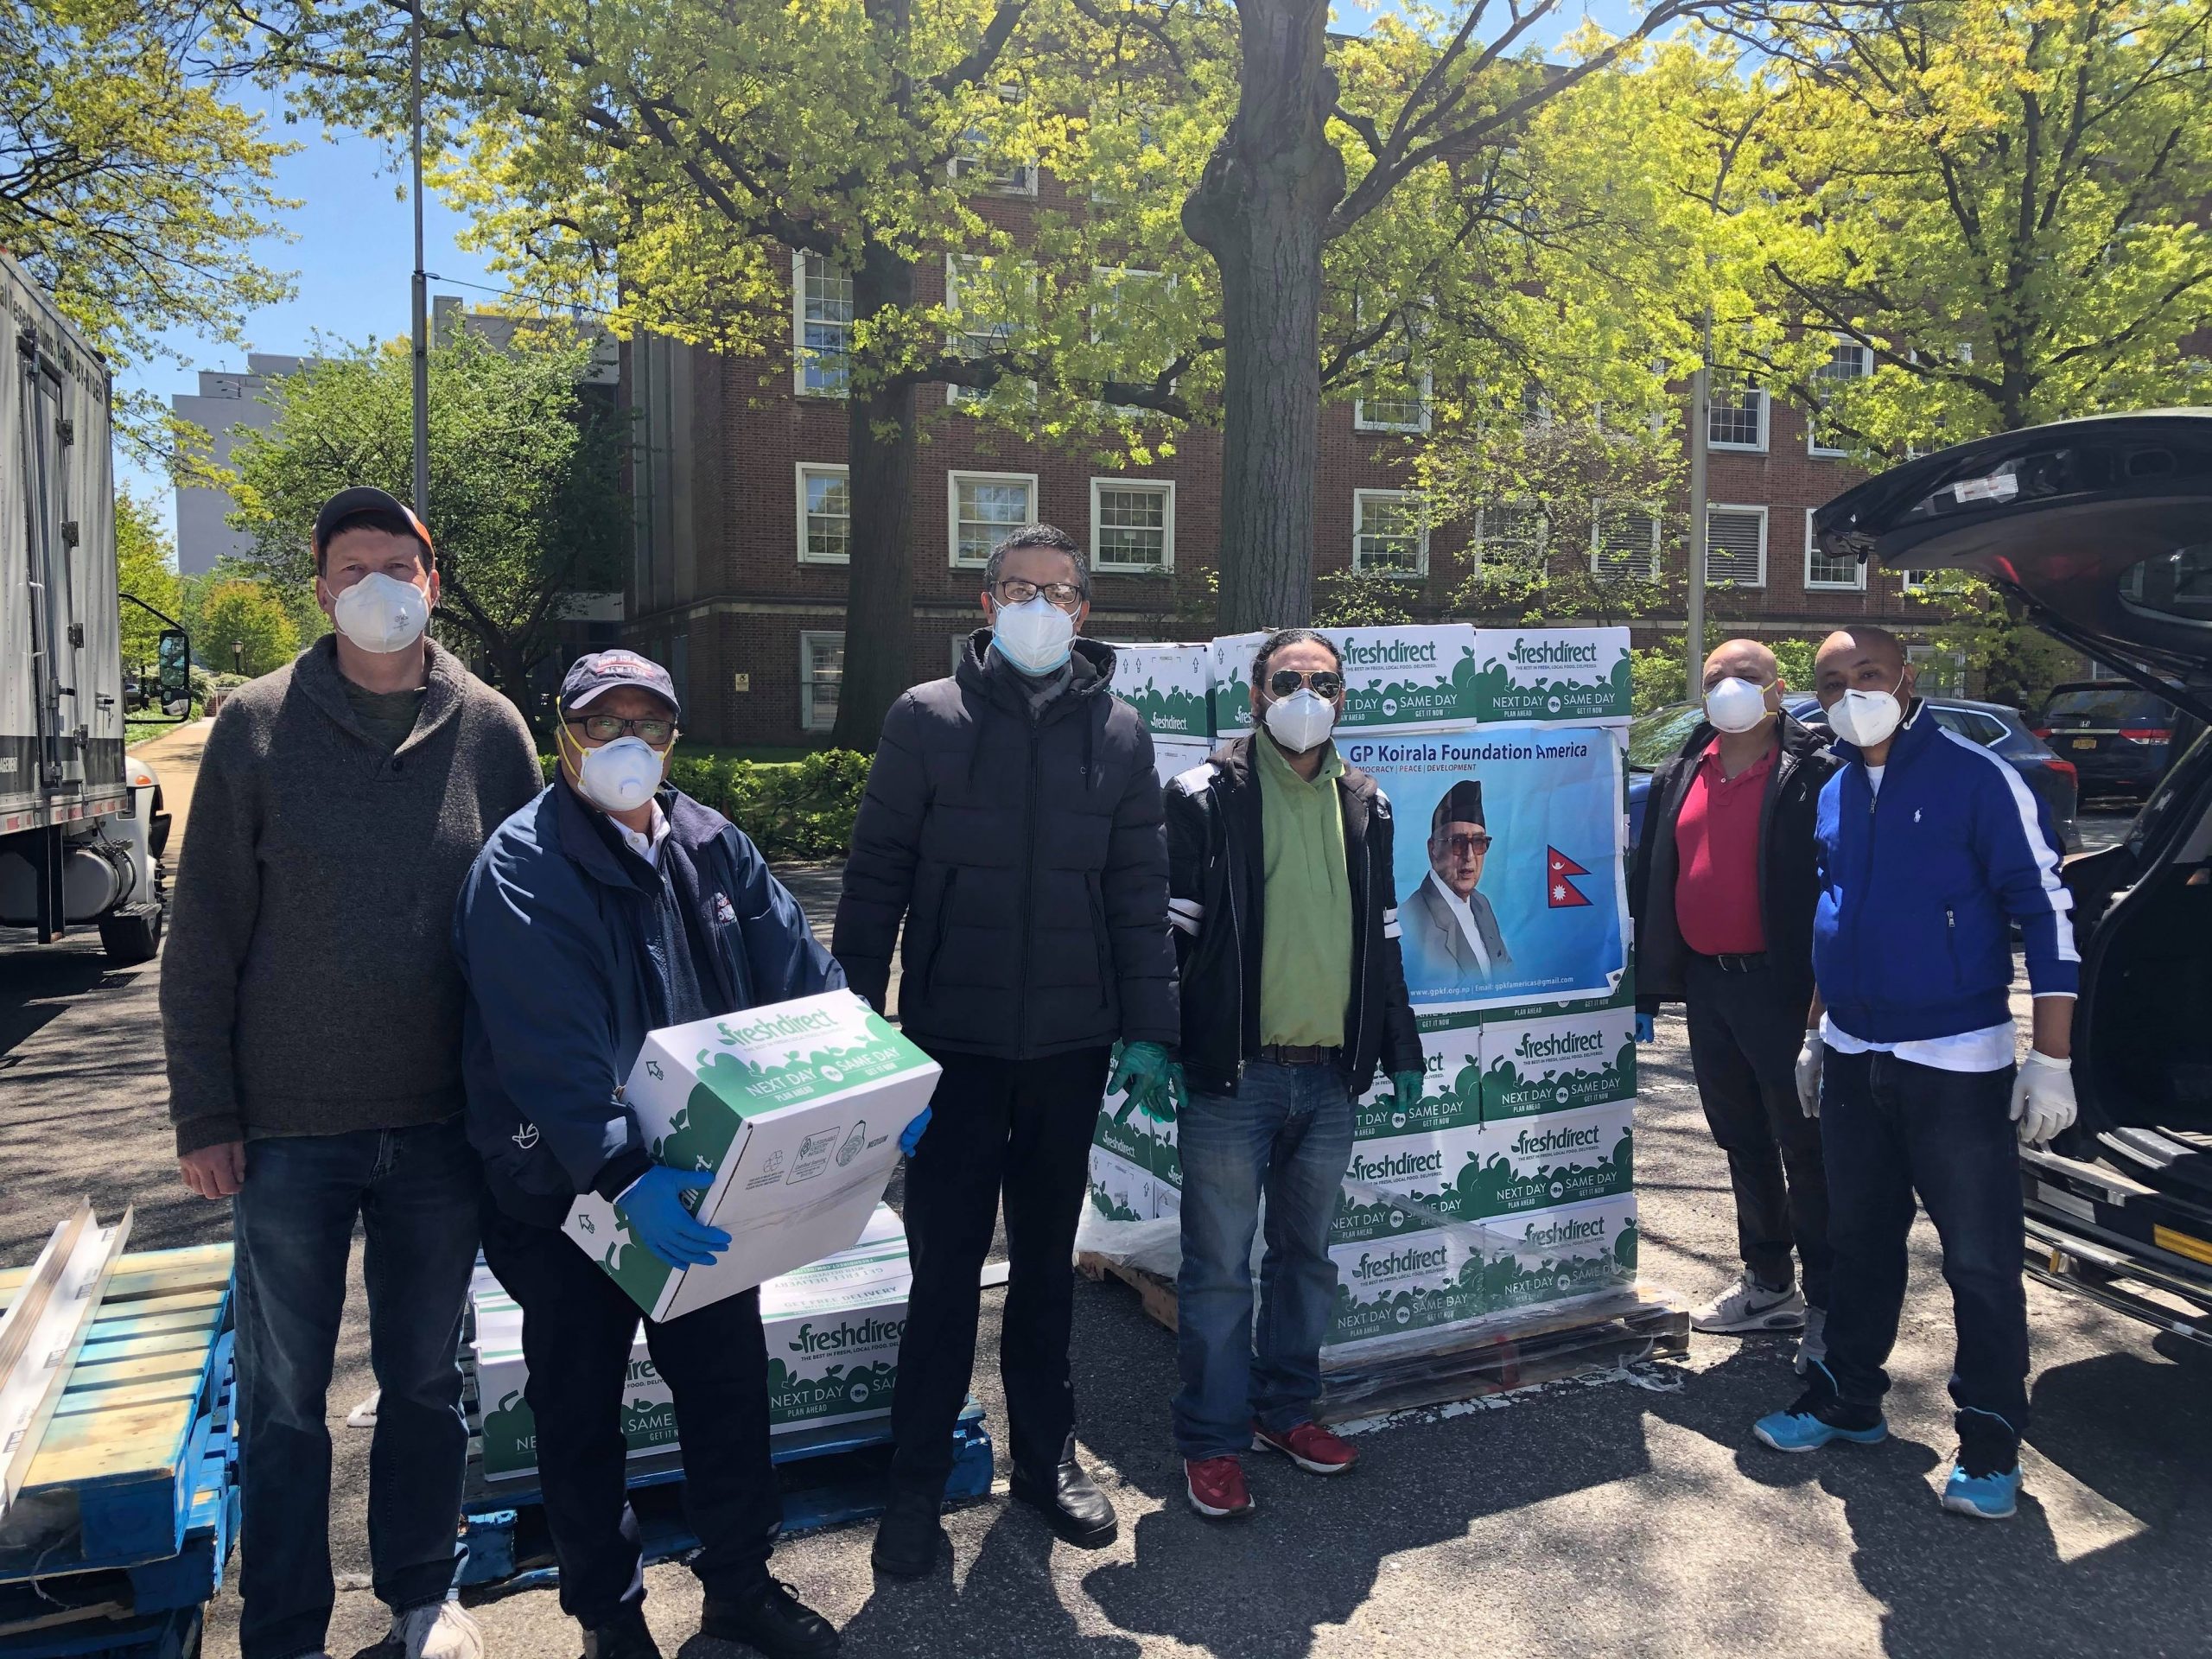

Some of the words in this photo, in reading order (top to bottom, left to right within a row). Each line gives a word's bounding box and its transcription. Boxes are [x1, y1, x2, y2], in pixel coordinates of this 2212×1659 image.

[1344, 637, 1436, 664] freshdirect
[1515, 638, 1597, 664] freshdirect
[1355, 697, 1378, 710] DAY
[1400, 695, 1433, 709] SAME
[1435, 694, 1458, 706] DAY
[1493, 696, 1520, 708] NEXT
[1522, 696, 1544, 707] DAY
[1563, 694, 1592, 705] SAME
[1595, 693, 1615, 703] DAY
[1152, 711, 1188, 729] freshdirect
[1350, 745, 1374, 762] GP
[1378, 744, 1436, 762] Koirala
[1441, 743, 1532, 761] Foundation
[1535, 741, 1588, 760] America
[1410, 987, 1471, 997] www.gpkf.org.np
[716, 1008, 838, 1046] freshdirect
[1440, 1018, 1450, 1027] NOW
[1522, 1030, 1604, 1058] freshdirect
[745, 1077, 787, 1097] NEXT
[785, 1067, 817, 1085] DAY
[836, 1053, 875, 1071] SAME
[872, 1046, 901, 1062] DAY
[774, 1091, 794, 1103] PLAN
[793, 1085, 815, 1098] AHEAD
[865, 1067, 878, 1077] GET
[884, 1062, 898, 1071] NOW
[1502, 1090, 1529, 1105] NEXT
[1532, 1087, 1553, 1101] DAY
[1571, 1081, 1599, 1095] SAME
[1601, 1077, 1621, 1090] DAY
[1366, 1112, 1389, 1125] DAY
[1408, 1104, 1439, 1119] SAME
[1442, 1101, 1464, 1114] DAY
[1513, 1105, 1525, 1114] PLAN
[867, 1135, 889, 1149] MEDIUM
[1104, 1130, 1136, 1158] freshdirect
[1359, 1128, 1375, 1137] AHEAD
[1518, 1125, 1599, 1154] freshdirect
[1352, 1150, 1442, 1181] freshdirect
[1497, 1187, 1523, 1201] NEXT
[1526, 1183, 1547, 1196] DAY
[1566, 1175, 1593, 1189] SAME
[1597, 1172, 1618, 1184] DAY
[1331, 1216, 1359, 1230] NEXT
[1363, 1211, 1386, 1225] DAY
[1440, 1199, 1462, 1211] DAY
[1521, 1198, 1535, 1206] AHEAD
[1342, 1230, 1356, 1239] PLAN
[1357, 1228, 1373, 1236] AHEAD
[864, 1267, 884, 1277] GET
[1359, 1245, 1447, 1280] freshdirect
[774, 1275, 829, 1288] DELIVERY
[835, 1271, 860, 1281] FREE
[1504, 1280, 1530, 1295] NEXT
[1534, 1276, 1554, 1289] DAY
[1573, 1268, 1599, 1281] SAME
[785, 1300, 807, 1308] GET
[807, 1297, 839, 1306] FREE
[842, 1287, 897, 1301] DELIVERY
[1338, 1313, 1366, 1329] NEXT
[1370, 1307, 1392, 1322] DAY
[1413, 1298, 1443, 1313] SAME
[1446, 1293, 1468, 1306] DAY
[1350, 1328, 1363, 1337] PLAN
[1363, 1325, 1380, 1334] AHEAD
[1443, 1310, 1454, 1319] NOW
[798, 1318, 906, 1354] freshdirec
[771, 1390, 810, 1409] NEXT
[815, 1384, 844, 1402] DAY
[873, 1377, 895, 1392] SA
[787, 1407, 804, 1417] PLAN
[806, 1403, 828, 1414] AHEAD
[517, 1435, 537, 1451] NE
[628, 1413, 672, 1432] SAME
[650, 1430, 663, 1441] GET
[665, 1429, 671, 1440] IT
